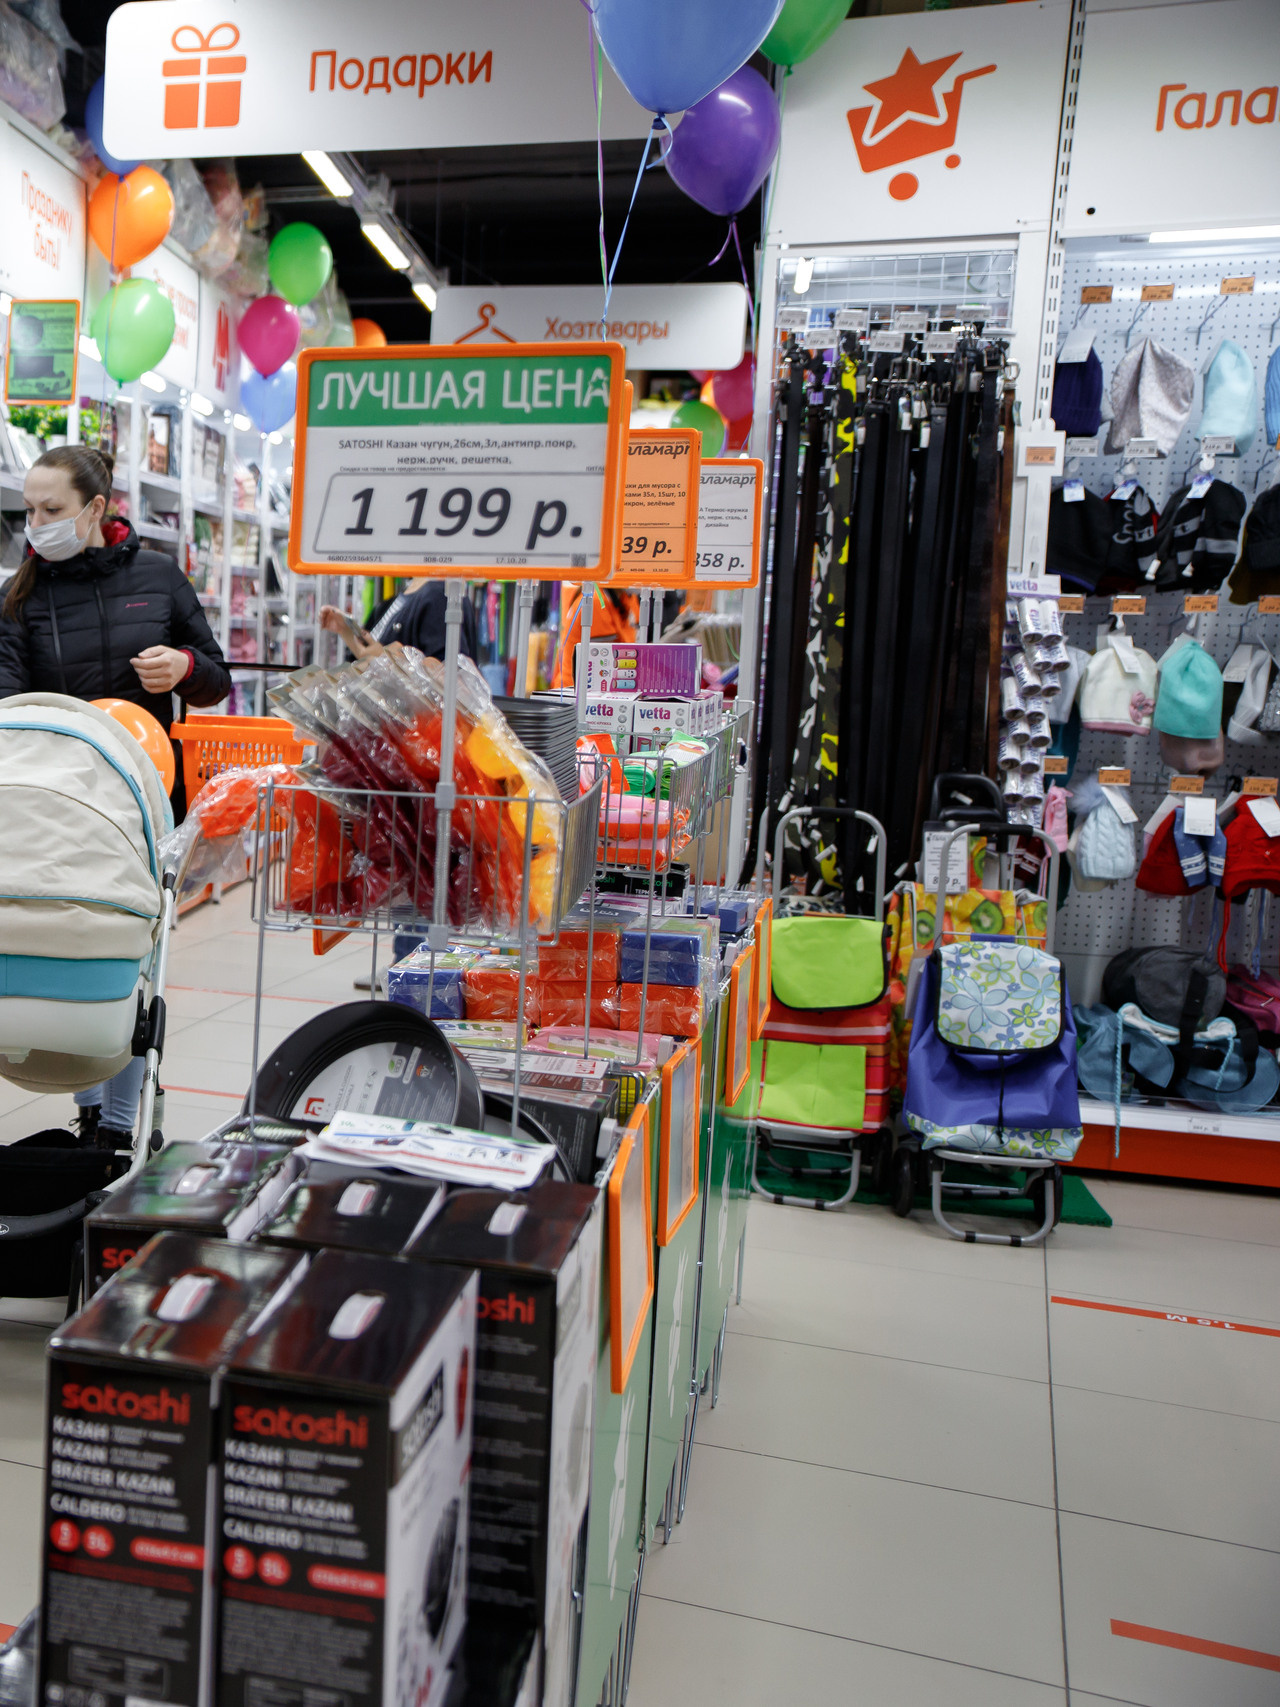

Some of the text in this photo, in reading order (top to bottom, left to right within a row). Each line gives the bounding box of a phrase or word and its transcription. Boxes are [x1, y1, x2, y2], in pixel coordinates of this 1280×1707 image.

[308, 49, 494, 98] Подарки
[21, 169, 73, 247] Празднику
[544, 316, 669, 345] Хозтовары
[317, 367, 610, 413] ЛУЧШАЯ ЦЕНА
[338, 439, 383, 449] SATOSHI
[386, 439, 418, 449] Казан
[398, 487, 512, 537] 199
[525, 500, 583, 550] р.
[652, 540, 672, 557] р.
[1009, 580, 1038, 591] vetta
[640, 707, 671, 720] vetta
[62, 1383, 190, 1426] satoshi
[53, 1415, 109, 1442] КАЗАН
[234, 1405, 368, 1449] satoshi
[53, 1438, 109, 1463] KAZAN
[225, 1438, 284, 1466] КАЗАН
[225, 1461, 283, 1489] KAZAN
[51, 1493, 126, 1523] CALDERO
[224, 1519, 303, 1549] CALDERO
